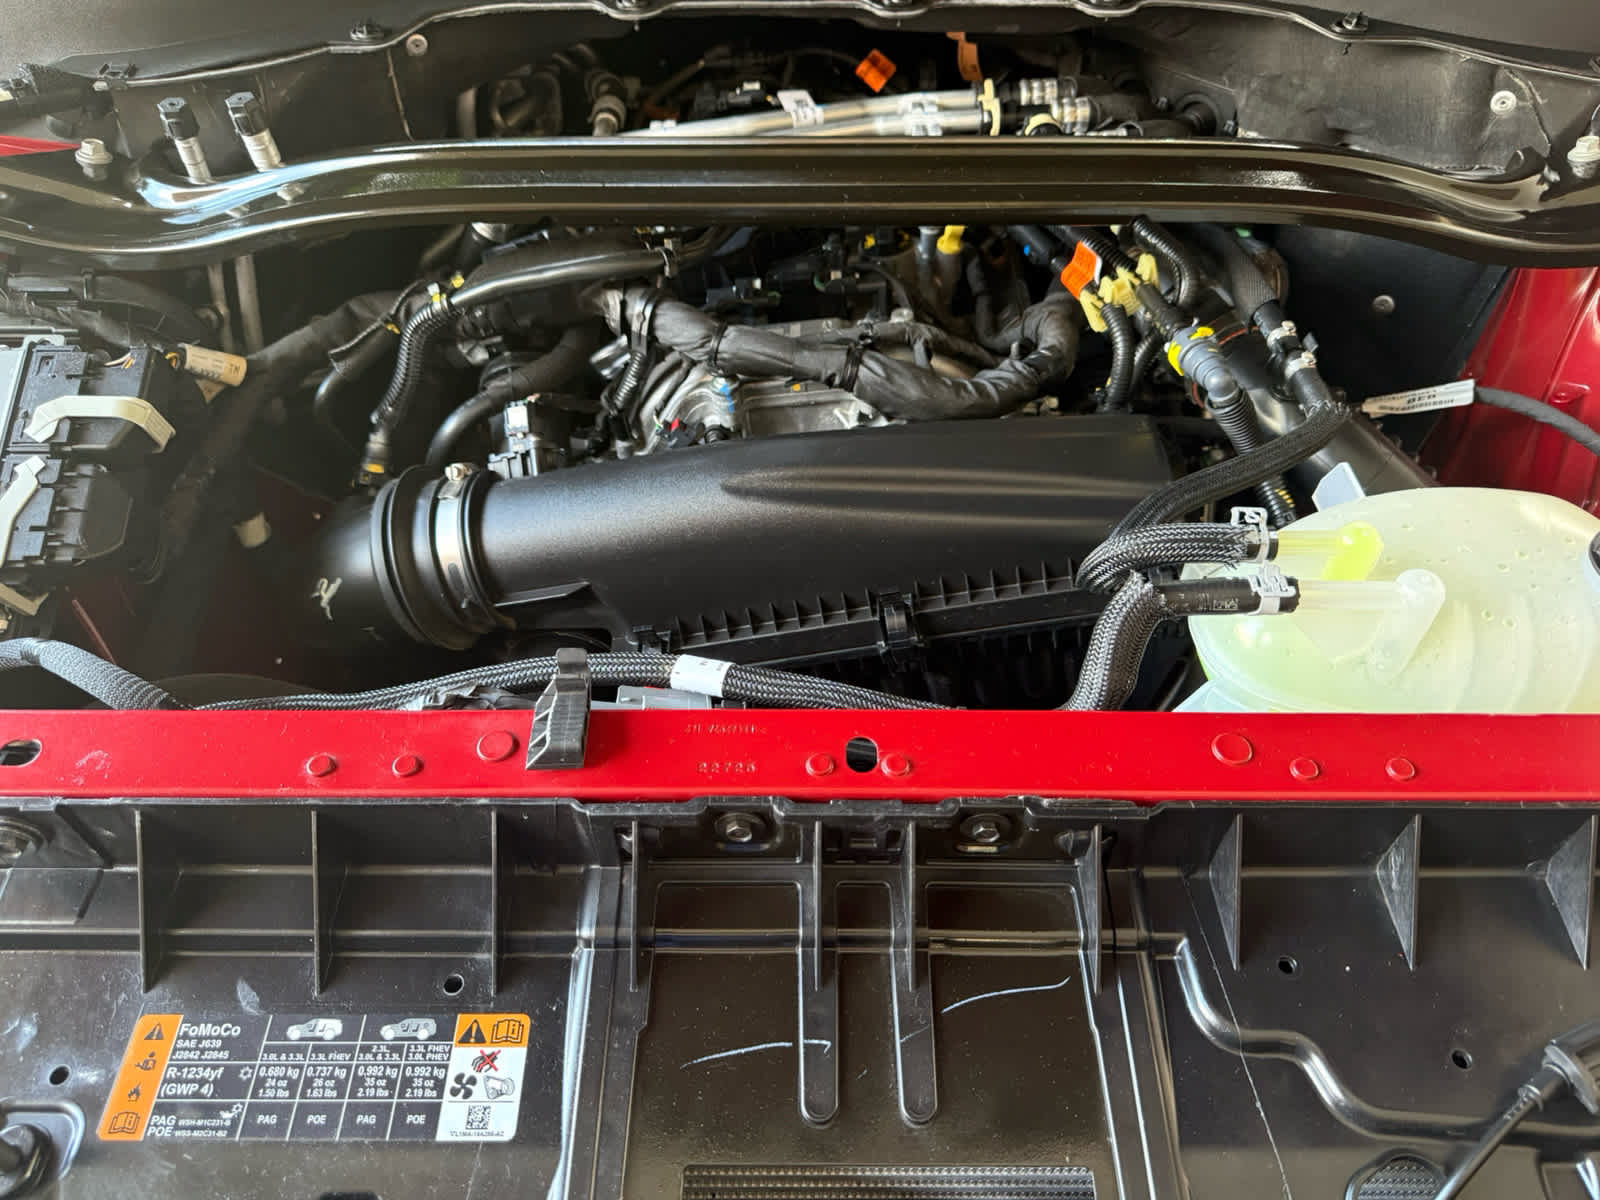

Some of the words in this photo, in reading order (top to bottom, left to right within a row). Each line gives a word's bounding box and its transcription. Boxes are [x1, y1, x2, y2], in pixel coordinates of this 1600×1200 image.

[180, 1023, 241, 1036] FoMoCo
[176, 1039, 197, 1048] SAE
[198, 1039, 222, 1048] J639
[172, 1050, 200, 1059] J2842
[201, 1050, 230, 1059] J2845
[166, 1067, 224, 1081] R-1234yf
[259, 1066, 286, 1077] 0.680
[287, 1066, 300, 1079] kg
[307, 1066, 333, 1077] 0.737
[334, 1066, 347, 1079] kg
[358, 1066, 384, 1077] 0.992
[385, 1066, 398, 1078] kg
[405, 1066, 432, 1077] 0.992
[433, 1066, 446, 1079] kg
[265, 1078, 277, 1087] 24
[312, 1078, 324, 1087] 26
[364, 1078, 376, 1087] 35
[376, 1079, 387, 1087] oz
[412, 1078, 423, 1087] 35
[160, 1083, 199, 1097] (GWP
[199, 1083, 214, 1097] 4)
[258, 1088, 276, 1097] 1.50
[276, 1088, 290, 1097] lbs
[306, 1088, 323, 1097] 1.63
[324, 1088, 337, 1097] lbs
[357, 1088, 375, 1097] 2.19
[376, 1088, 389, 1097] lbs
[405, 1088, 423, 1097] 2.19
[424, 1088, 437, 1097] lbs
[150, 1115, 177, 1126] PAG
[256, 1114, 278, 1124] PAG
[306, 1114, 327, 1124] POE
[356, 1114, 377, 1124] PAG
[406, 1114, 426, 1124] POE
[147, 1127, 174, 1137] POE
